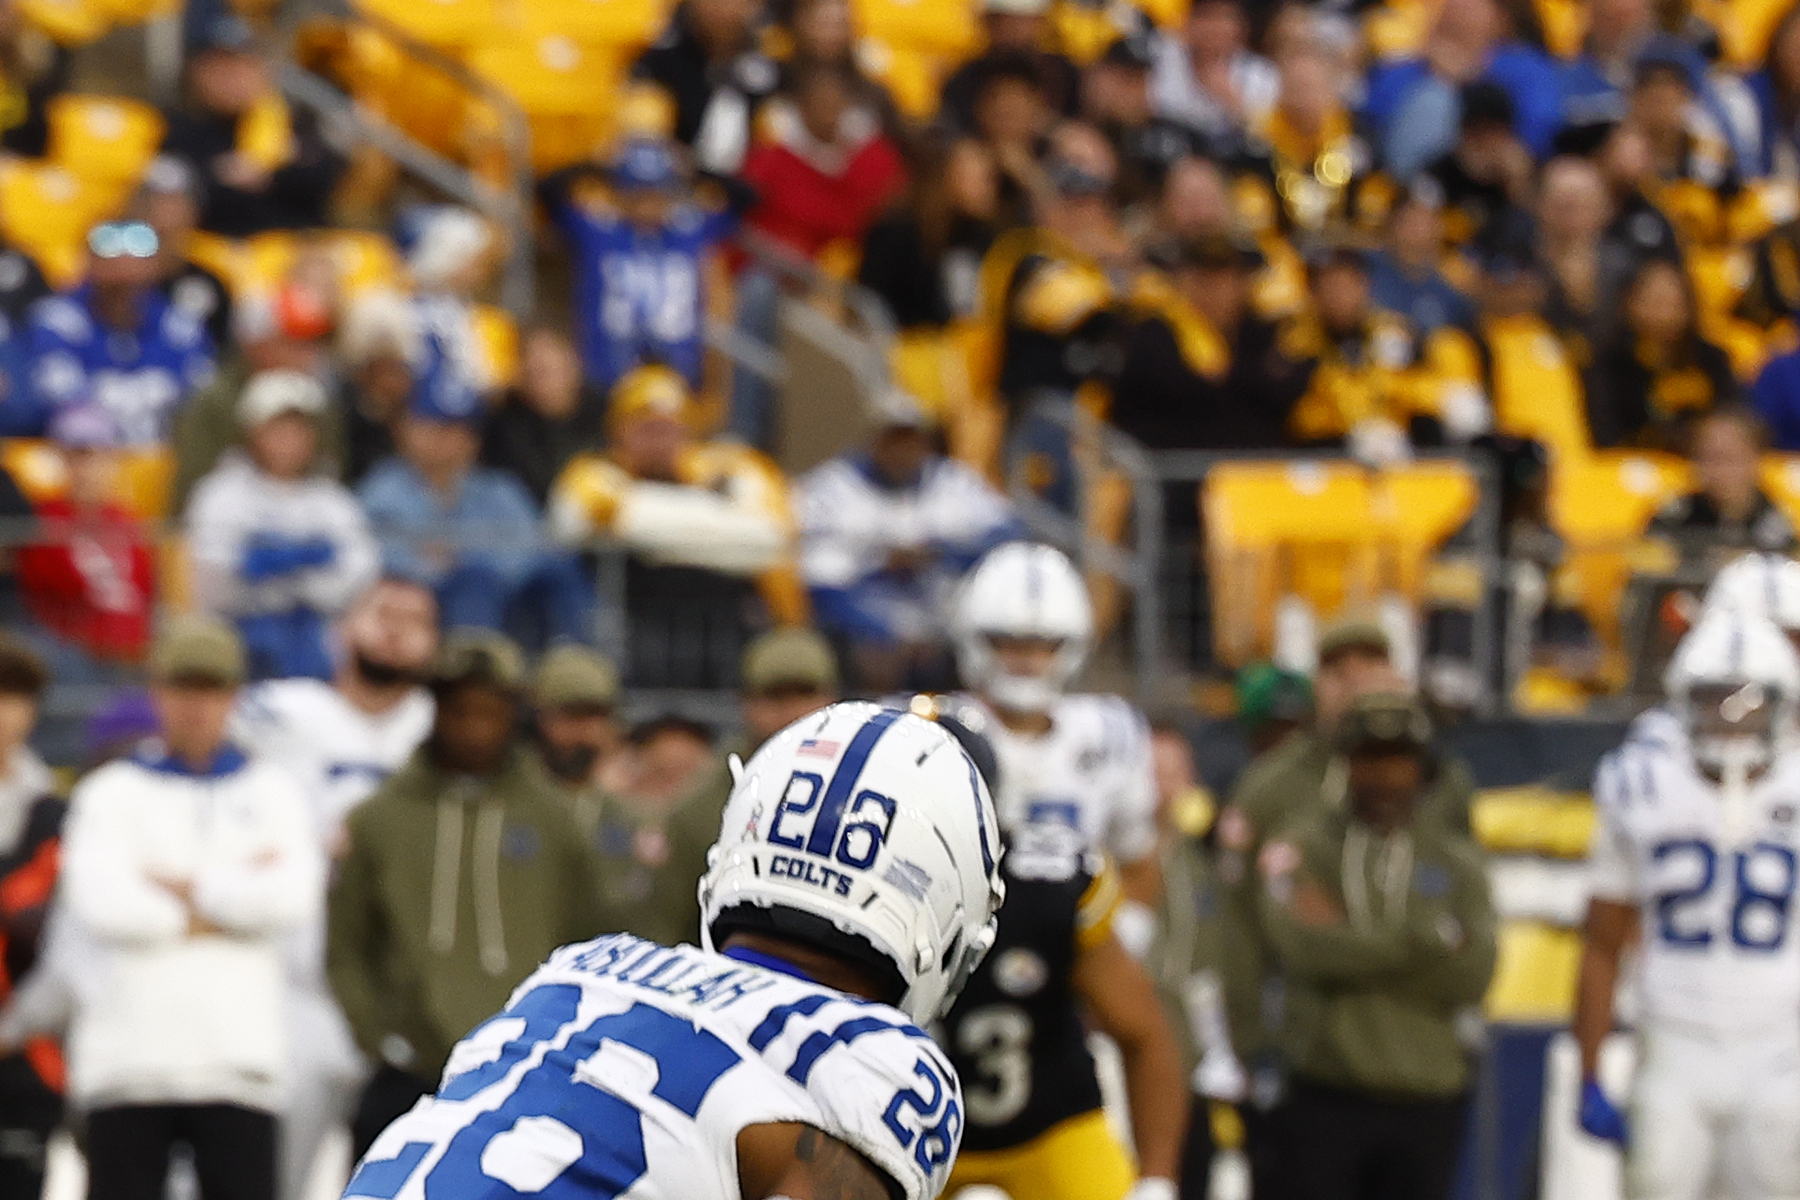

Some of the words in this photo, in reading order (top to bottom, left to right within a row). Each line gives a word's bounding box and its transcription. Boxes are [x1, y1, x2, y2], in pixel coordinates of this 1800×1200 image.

[767, 769, 898, 872] 26
[769, 854, 853, 898] COLTS
[1652, 838, 1795, 952] 28
[881, 1056, 961, 1178] 26
[935, 1002, 1035, 1126] 3
